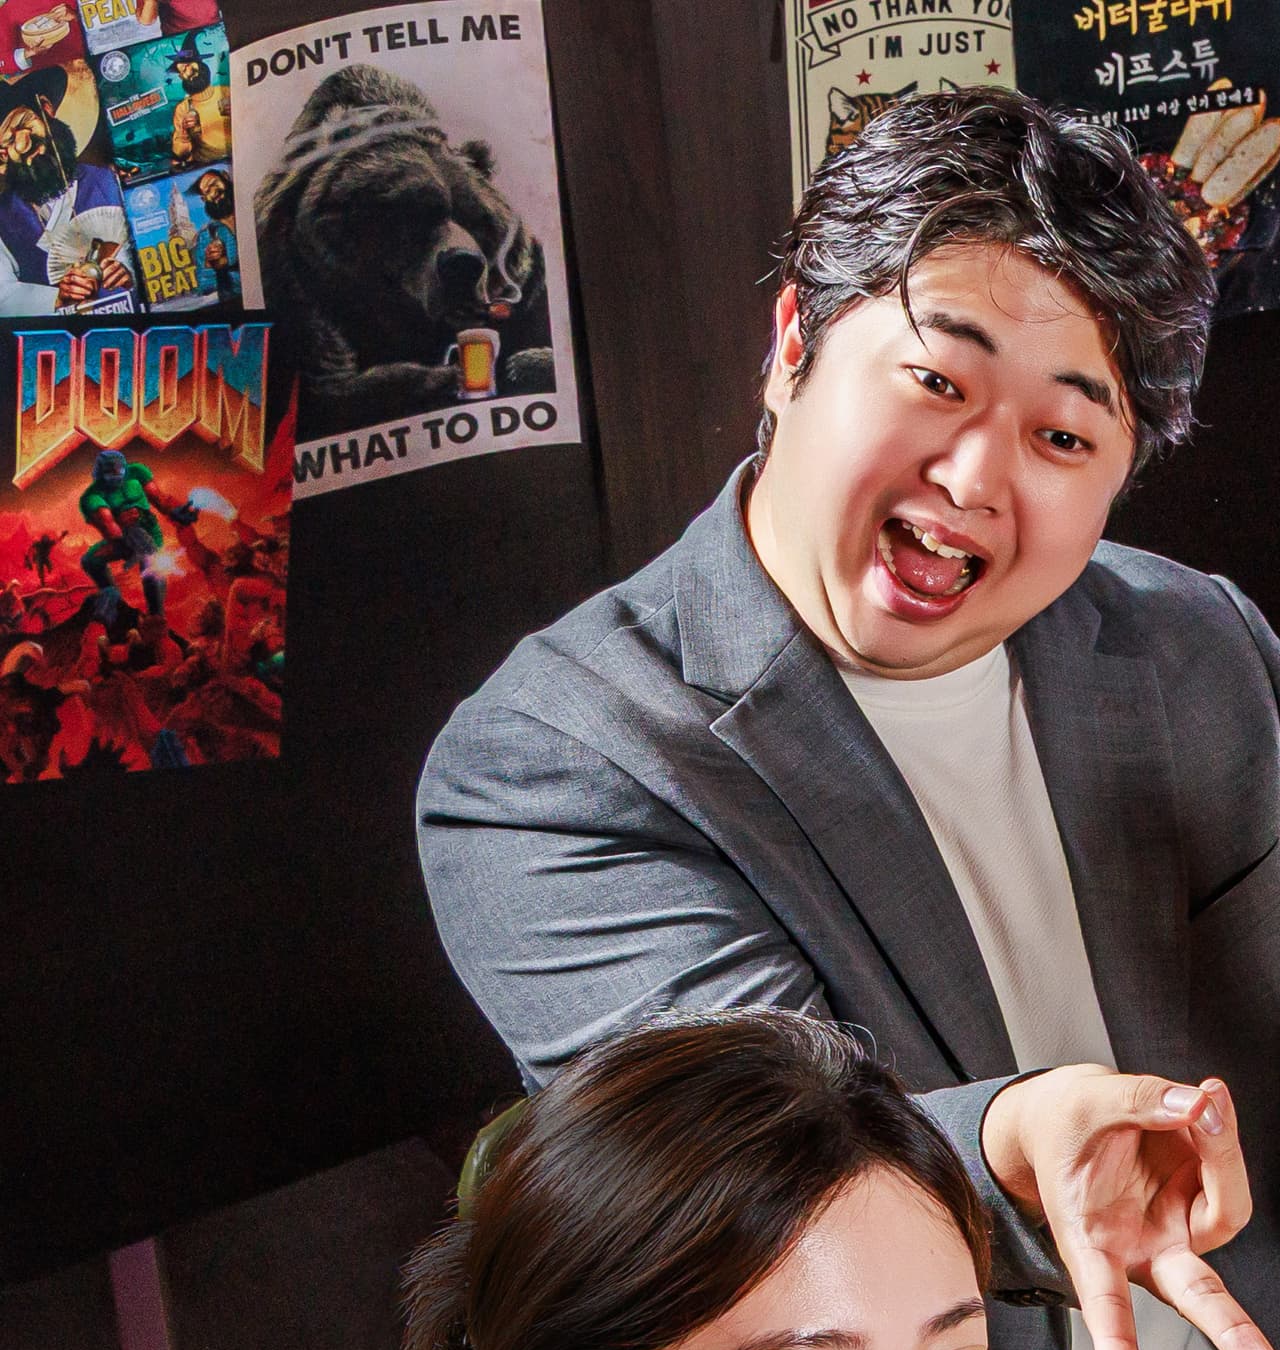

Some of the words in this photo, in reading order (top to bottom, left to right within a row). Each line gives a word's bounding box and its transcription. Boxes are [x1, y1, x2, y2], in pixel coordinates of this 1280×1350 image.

[822, 7, 858, 37] NO
[868, 0, 953, 21] THANK
[247, 31, 352, 87] DON'T
[363, 18, 449, 52] TELL
[460, 14, 521, 43] ME
[868, 35, 903, 60] I'M
[918, 30, 986, 56] JUST
[1094, 38, 1220, 96] 비프스튜
[139, 236, 191, 280] BIG
[146, 266, 199, 304] PEAT
[13, 322, 274, 489] DOOM
[293, 425, 412, 483] WHAT
[422, 405, 480, 446] TO
[491, 400, 558, 437] DO
